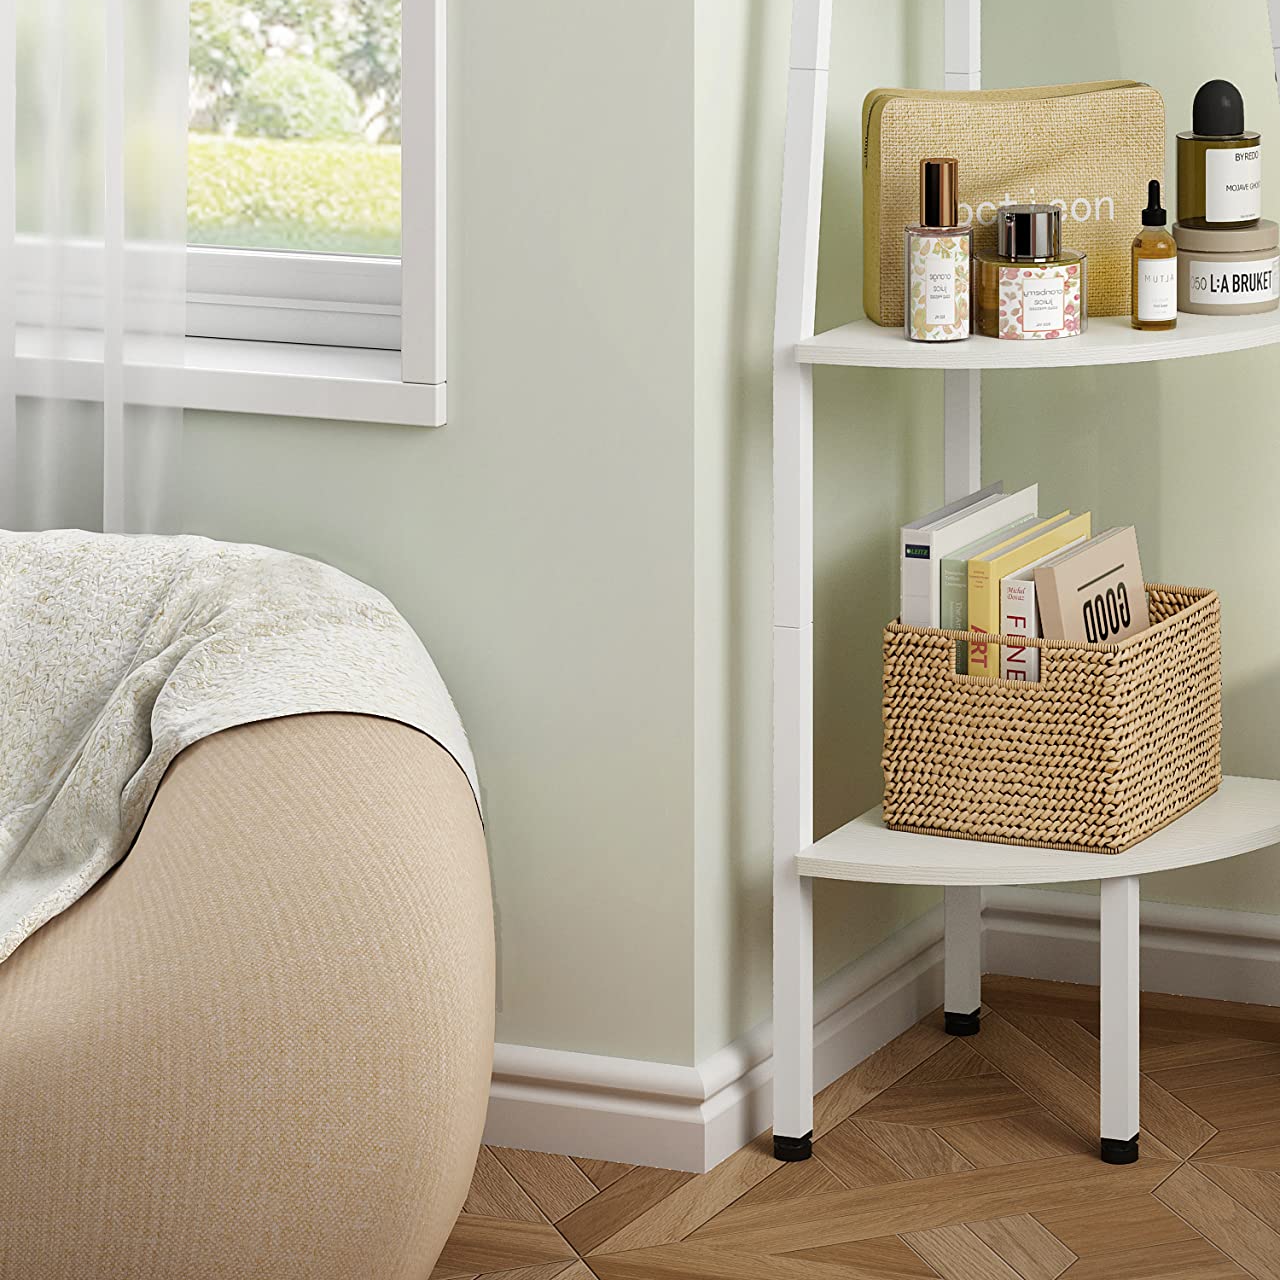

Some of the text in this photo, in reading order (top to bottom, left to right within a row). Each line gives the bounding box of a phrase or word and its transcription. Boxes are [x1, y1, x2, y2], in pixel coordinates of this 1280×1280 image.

[1234, 151, 1259, 161] BYREDO
[1226, 183, 1249, 192] MOJAVE
[1232, 270, 1272, 293] BRUKET
